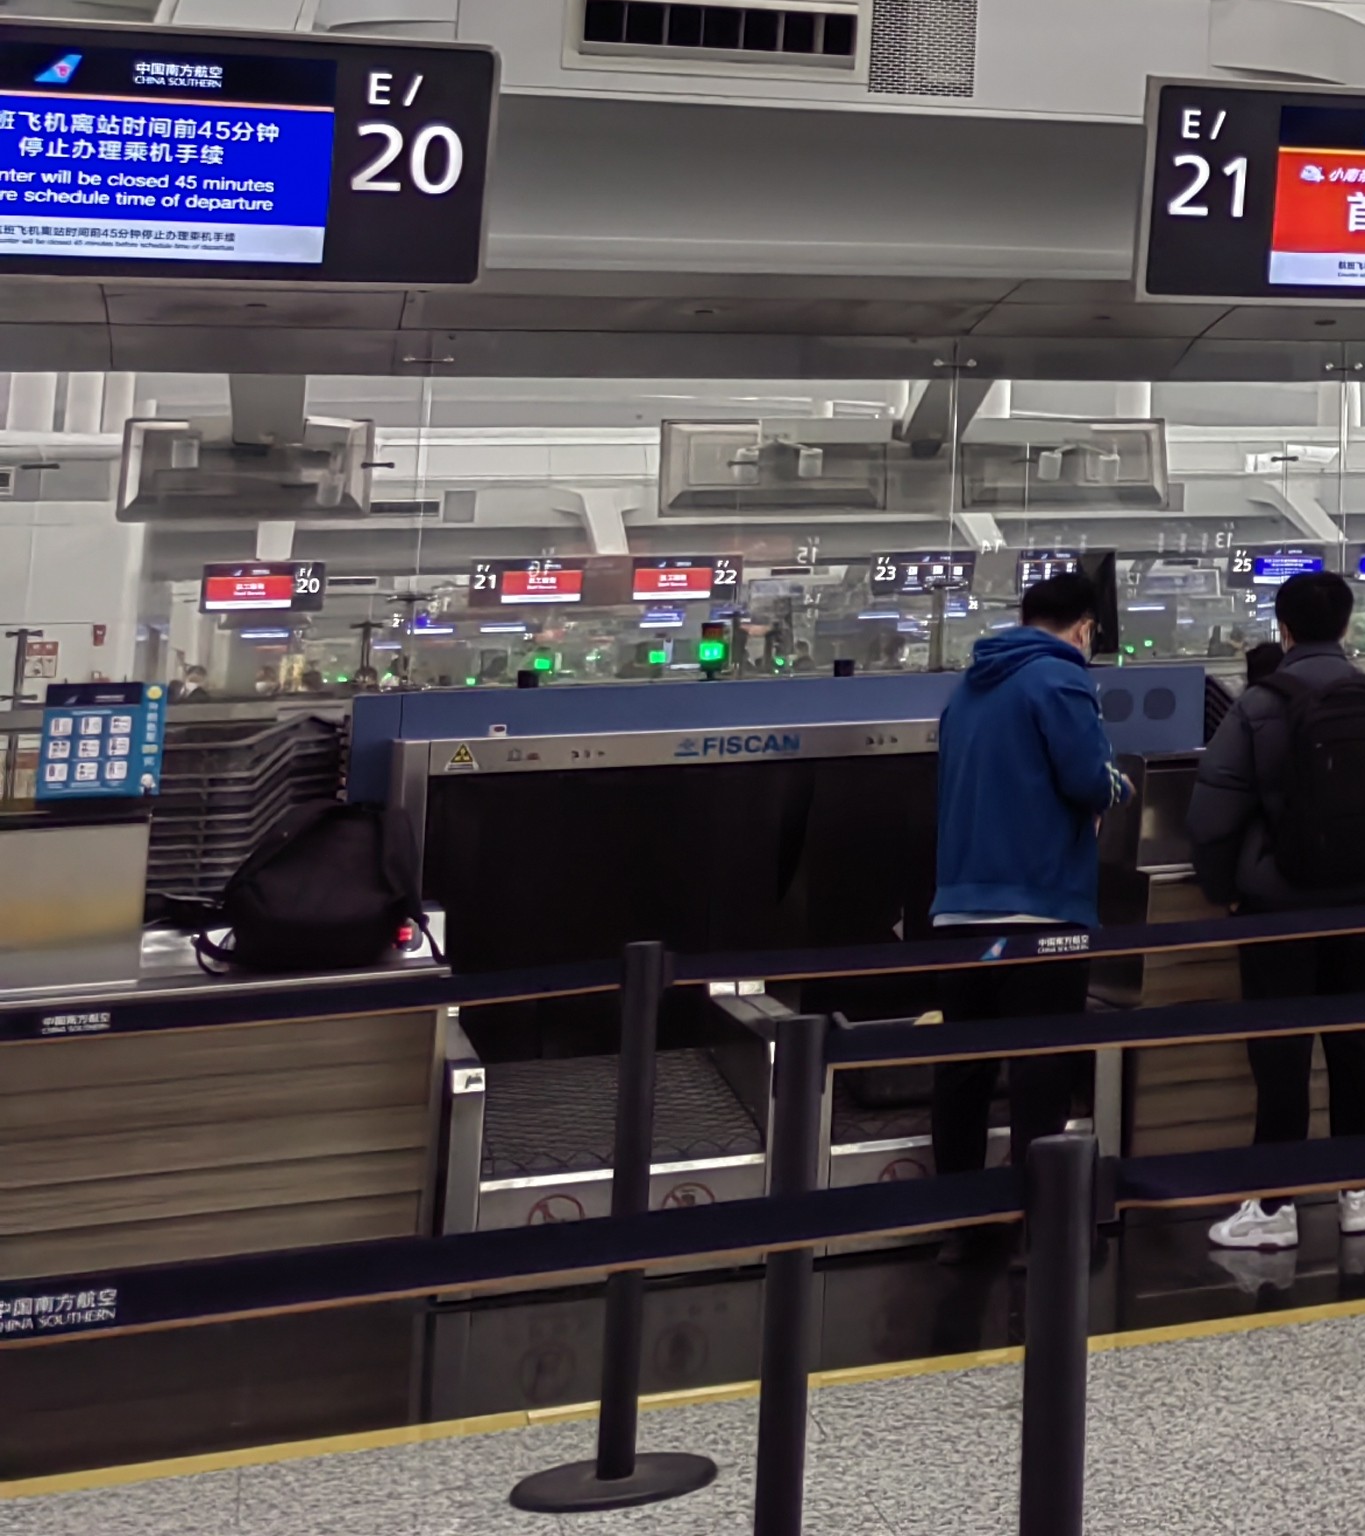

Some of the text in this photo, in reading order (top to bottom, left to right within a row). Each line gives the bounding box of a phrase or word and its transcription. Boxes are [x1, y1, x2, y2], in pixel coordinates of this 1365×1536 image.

[135, 62, 224, 79] 中国南方航空
[134, 75, 223, 88] CHINA SOUTHERN
[18, 136, 225, 165] 停止办理乘机手续
[350, 123, 465, 196] 20
[41, 169, 72, 185] will
[77, 171, 102, 186] be
[107, 172, 170, 189] closed
[174, 175, 198, 190] 45
[202, 176, 275, 193] minutes
[1166, 154, 1248, 218] 21
[24, 189, 110, 206] schedule
[115, 192, 156, 207] time
[161, 193, 181, 208] of
[185, 194, 274, 212] departure
[874, 565, 896, 581] 23
[1232, 558, 1252, 573] 25
[295, 577, 320, 594] 20
[474, 574, 497, 590] 21
[713, 569, 738, 585] 22
[703, 733, 800, 756] FISCAN
[39, 1307, 117, 1328] SOUTHERN
